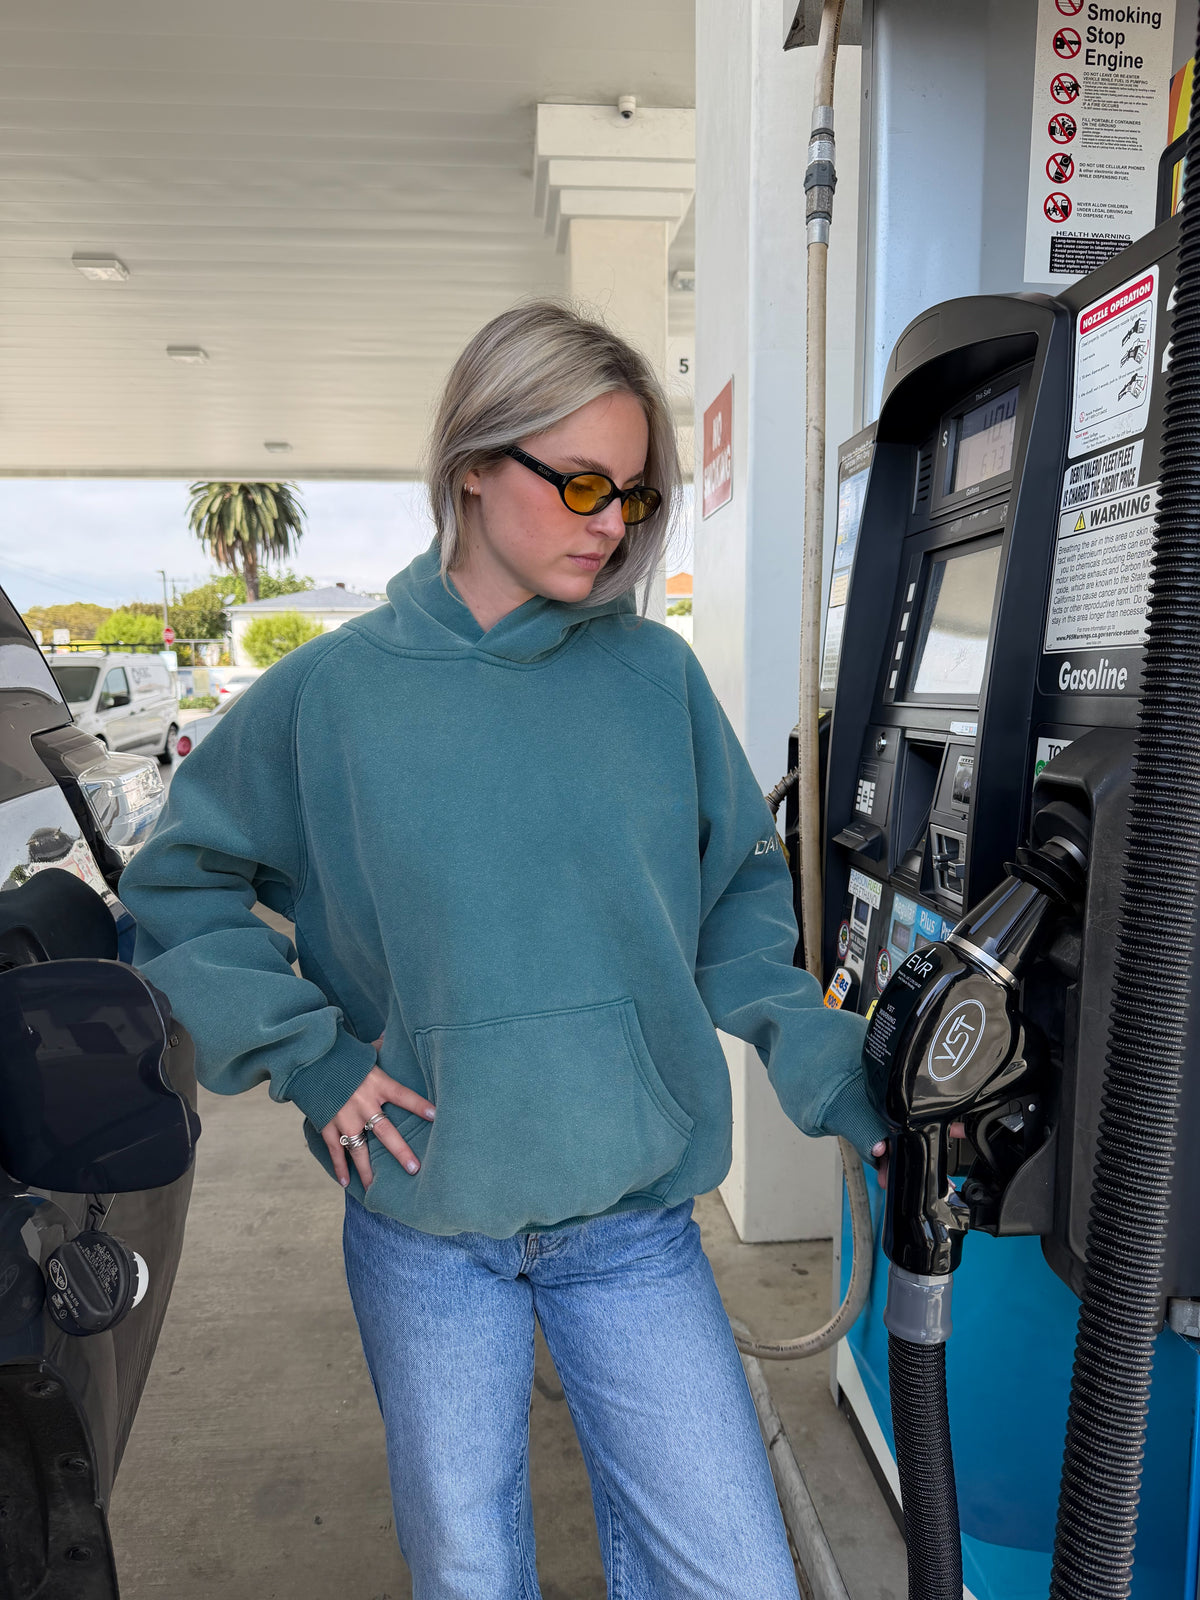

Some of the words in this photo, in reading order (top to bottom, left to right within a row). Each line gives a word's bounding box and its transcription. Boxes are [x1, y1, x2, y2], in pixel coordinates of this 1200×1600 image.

[1088, 3, 1161, 29] Smoking
[1086, 26, 1125, 48] Stop
[1086, 49, 1143, 71] Engine
[1083, 307, 1108, 329] NOZZLE
[1110, 282, 1150, 313] OPERATION
[679, 358, 688, 373] 5
[942, 430, 948, 448] $
[1084, 458, 1102, 480] VALERO
[1118, 446, 1134, 468] FLEET
[966, 486, 980, 496] Gallons
[1063, 490, 1068, 507] IS
[1068, 483, 1090, 505] CHARGED
[1090, 479, 1100, 498] THE
[1100, 473, 1119, 495] CREDIT
[1119, 467, 1136, 490] PRICE
[1090, 494, 1150, 526] WARNING
[1058, 543, 1080, 554] Breathing
[1137, 528, 1148, 536] skin
[1077, 549, 1102, 560] petroleum
[1103, 544, 1126, 556] products
[1076, 560, 1100, 570] chemicals
[1101, 555, 1125, 566] including
[1127, 549, 1153, 560] Benzene,
[1070, 574, 1086, 582] vehicle
[1087, 568, 1108, 578] exhaust
[1120, 561, 1140, 572] Carbon
[1056, 586, 1069, 594] oxide,
[1071, 582, 1085, 590] which
[1096, 578, 1112, 587] known
[1120, 574, 1129, 582] the
[1131, 572, 1146, 582] State
[1054, 595, 1075, 605] California
[1082, 592, 1097, 601] cause
[1099, 589, 1116, 598] cancer
[1118, 586, 1128, 594] and
[1130, 584, 1142, 593] birth
[1070, 604, 1082, 612] other
[1083, 601, 1114, 611] reproductive
[1116, 598, 1130, 606] harm.
[1134, 595, 1142, 603] Do
[1052, 617, 1061, 626] stay
[1089, 612, 1106, 621] longer
[1106, 610, 1119, 618] than
[1059, 658, 1128, 690] Gasoline
[1048, 744, 1062, 760] TO
[894, 896, 915, 921] Regular
[920, 910, 935, 934] Plus
[906, 954, 933, 978] EVR
[879, 1008, 897, 1025] WARNING
[886, 1004, 896, 1014] VST
[934, 1014, 976, 1068] VST
